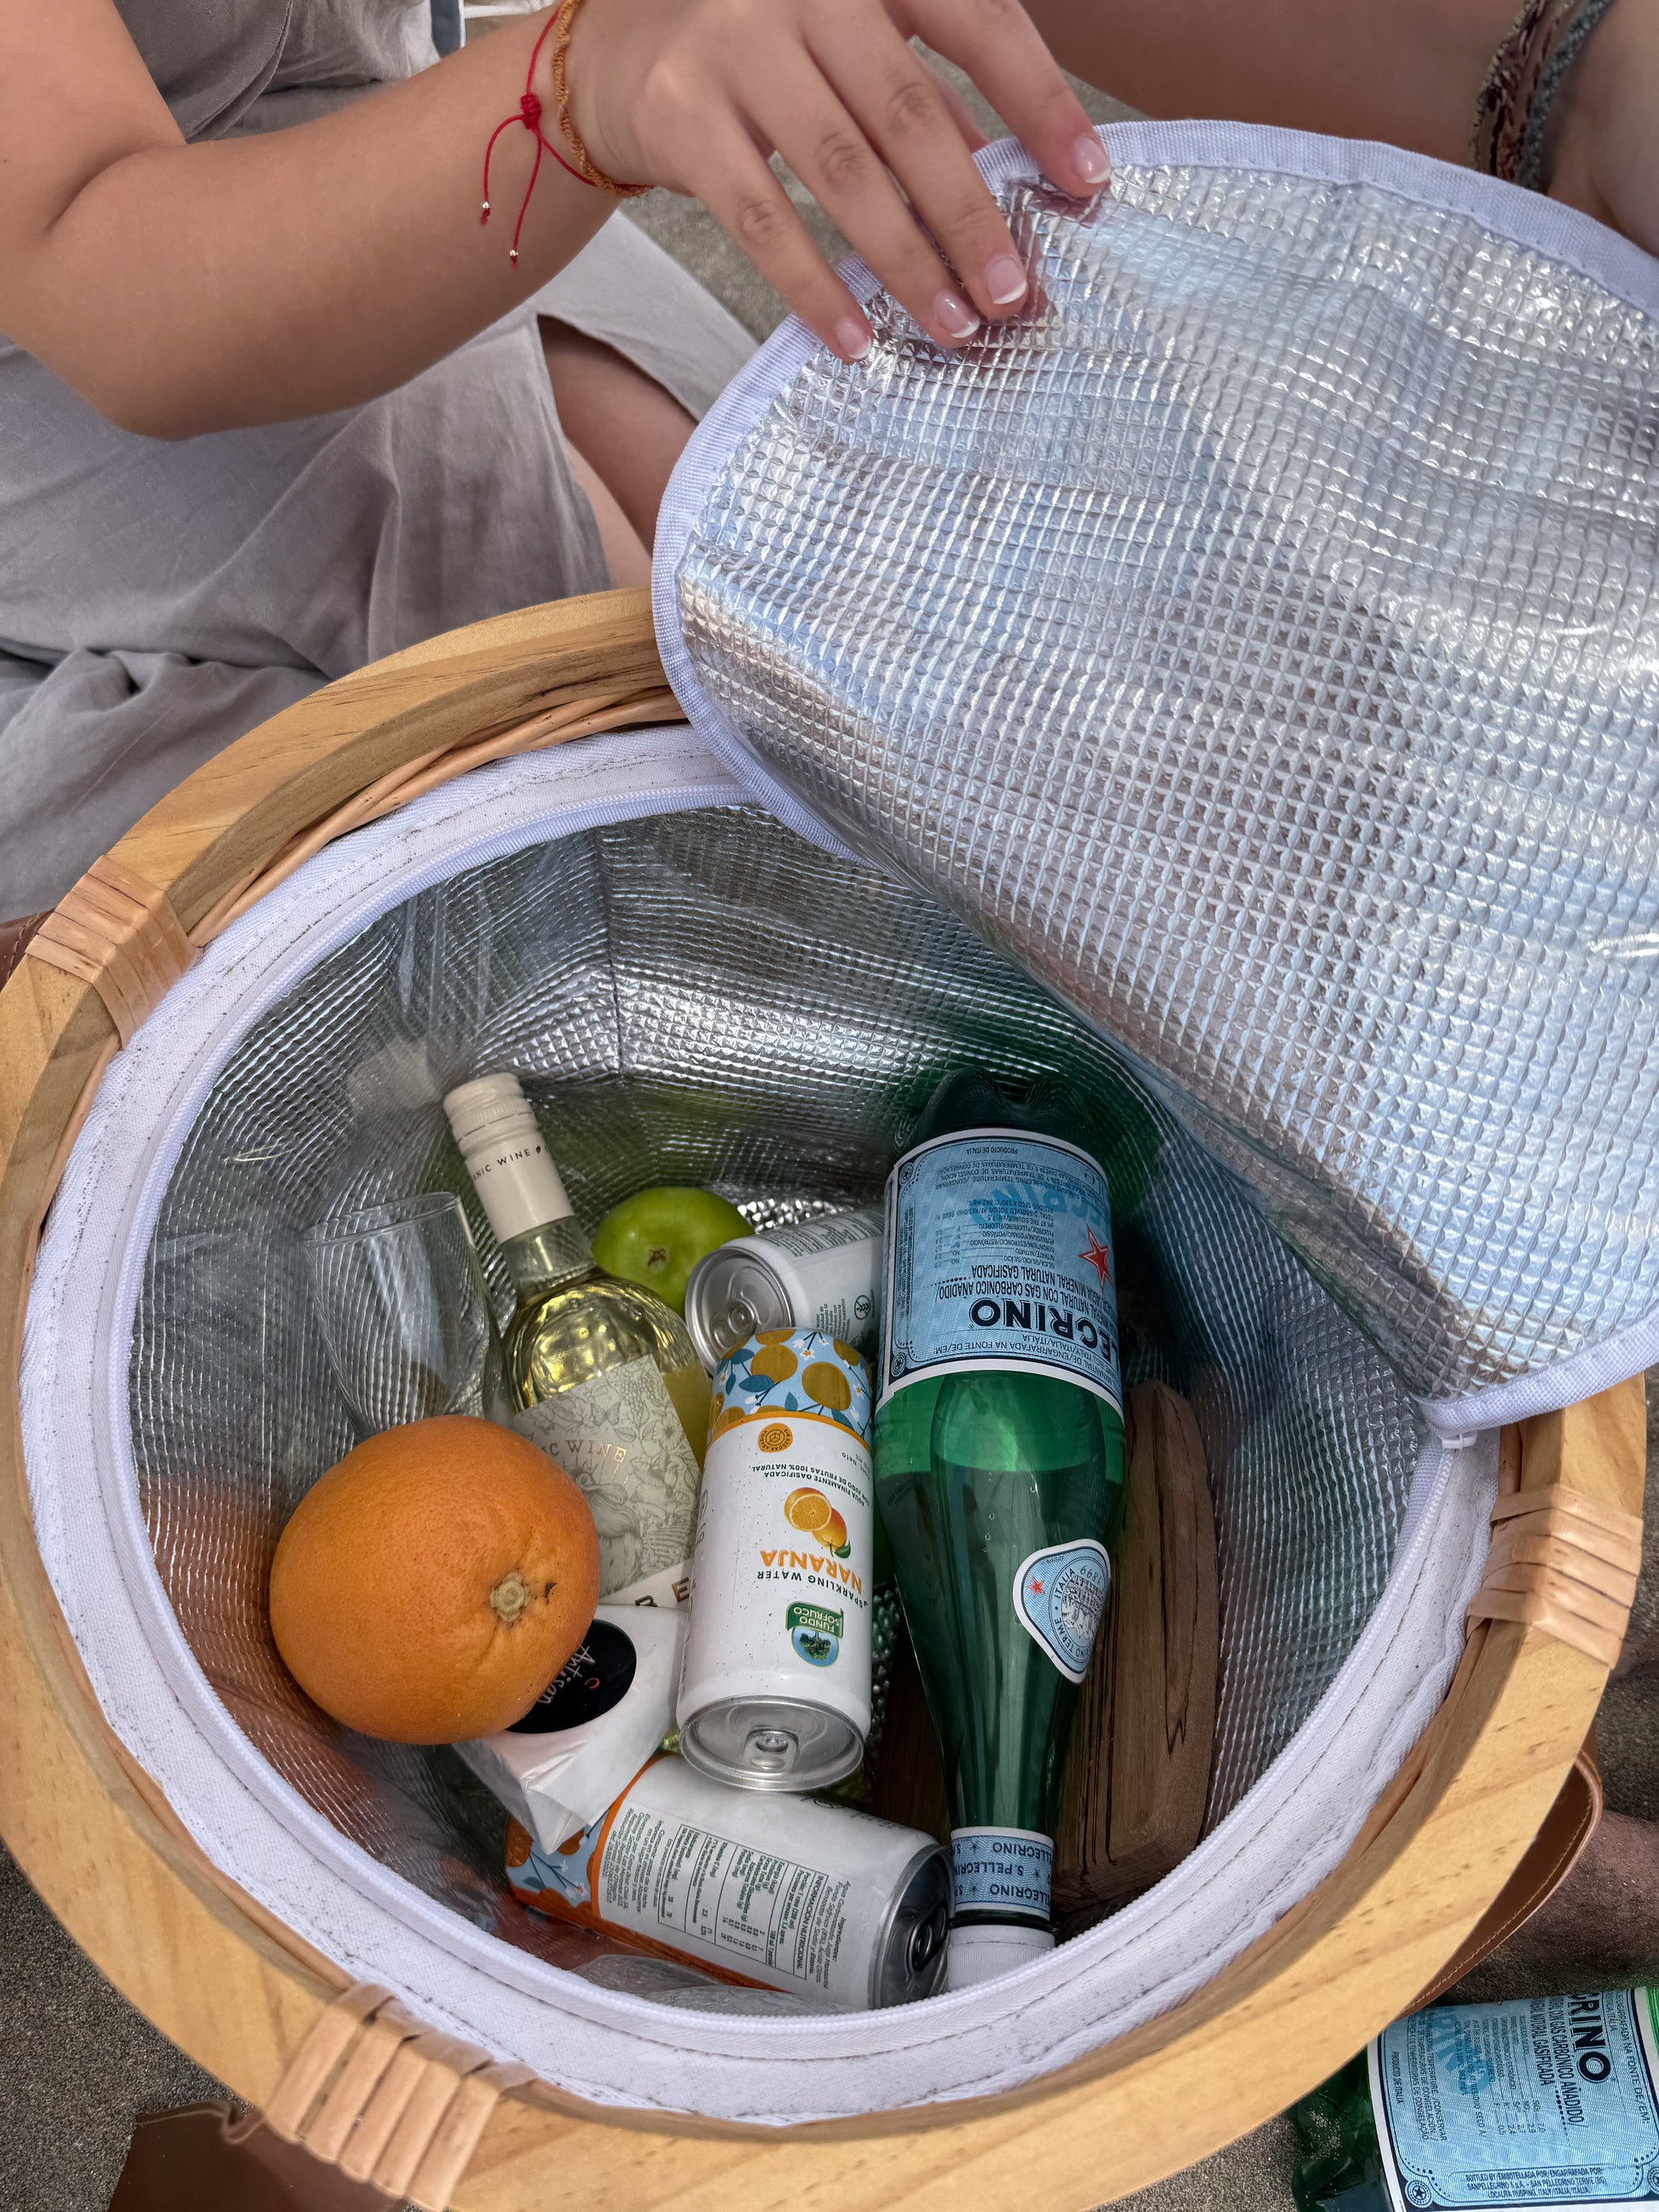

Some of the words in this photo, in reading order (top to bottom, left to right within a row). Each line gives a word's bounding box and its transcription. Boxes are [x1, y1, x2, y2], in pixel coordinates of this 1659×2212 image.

[497, 1148, 531, 1165] WINE
[991, 1146, 1017, 1154] PRODUCTO
[971, 1264, 1018, 1279] GASIFICADA
[1020, 1266, 1054, 1283] NATURAL
[975, 1280, 1022, 1298] CARBÓNICO
[1025, 1283, 1040, 1298] GAS
[1043, 1286, 1057, 1302] CON
[933, 1343, 962, 1354] DE/EM:
[965, 1341, 992, 1349] FONTE
[995, 1341, 1007, 1349] NA
[565, 1440, 627, 1462] WINE
[841, 1451, 856, 1466] Neto
[763, 1470, 812, 1479] GASIFICADA
[809, 1466, 836, 1481] FRUTAS
[839, 1476, 846, 1484] DE
[813, 1475, 850, 1495] FINAMENTE
[756, 1570, 801, 1581] WATER
[760, 1549, 862, 1596] NARANJA
[807, 1574, 862, 1608] SPARKLING
[1055, 1567, 1075, 1599] ITALIA
[793, 1606, 840, 1626] SOFRUCO
[799, 1615, 834, 1632] FUNDO
[1054, 1618, 1075, 1655] TERME
[631, 1811, 645, 1834] Camino
[643, 1837, 650, 1845] un
[646, 1828, 653, 1837] en
[624, 1834, 635, 1854] Sector
[630, 1841, 639, 1853] por
[646, 1844, 653, 1852] en
[650, 1828, 665, 1858] Consumir
[621, 1854, 629, 1866] Las
[636, 1845, 647, 1863] lugar
[645, 1858, 655, 1876] antes
[643, 1876, 650, 1885] de
[839, 1880, 851, 1897] Agua
[802, 1874, 824, 1925] INFORMACIÓN
[830, 1881, 842, 1902] Fundo
[818, 1886, 833, 1915] Benzoato
[815, 1916, 824, 1926] de
[823, 1902, 835, 1927] Sofruco
[812, 1926, 820, 1946] Sodio
[830, 1916, 847, 1961] Ingredientes:
[795, 1924, 808, 1970] NUTRICIONAL
[1549, 2020, 1566, 2033] GAS
[1391, 2051, 1401, 2076] PRODUCTO
[1532, 2038, 1555, 2086] GASIFICADA
[1551, 2034, 1575, 2079] CARBÓNICO
[1421, 2076, 1429, 2085] DE
[1626, 2055, 1639, 2084] FONTE
[1633, 2087, 1650, 2123] DE/EM:
[1394, 2083, 1403, 2104] ITALIA
[1413, 2087, 1420, 2095] DE
